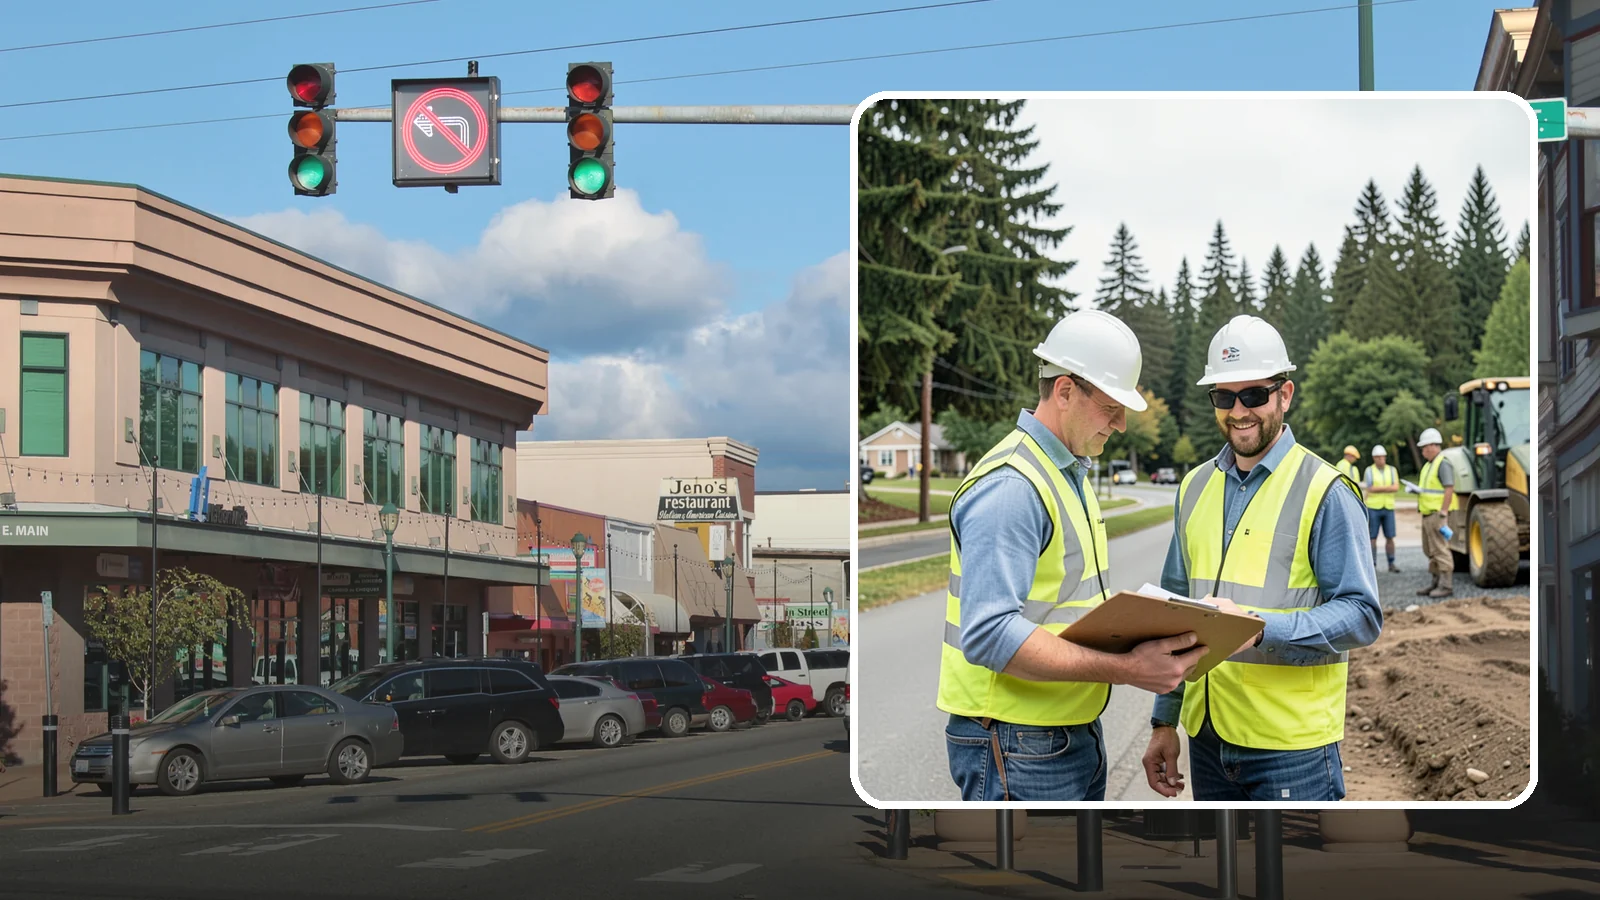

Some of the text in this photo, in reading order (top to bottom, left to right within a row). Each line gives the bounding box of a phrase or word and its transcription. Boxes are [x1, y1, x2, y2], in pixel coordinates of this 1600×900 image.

[669, 479, 728, 495] Jeno's
[664, 496, 731, 509] restaurant
[686, 509, 714, 520] American
[714, 509, 738, 520] Cuisine
[2, 525, 49, 537] E. MAIN
[797, 607, 828, 617] Street
